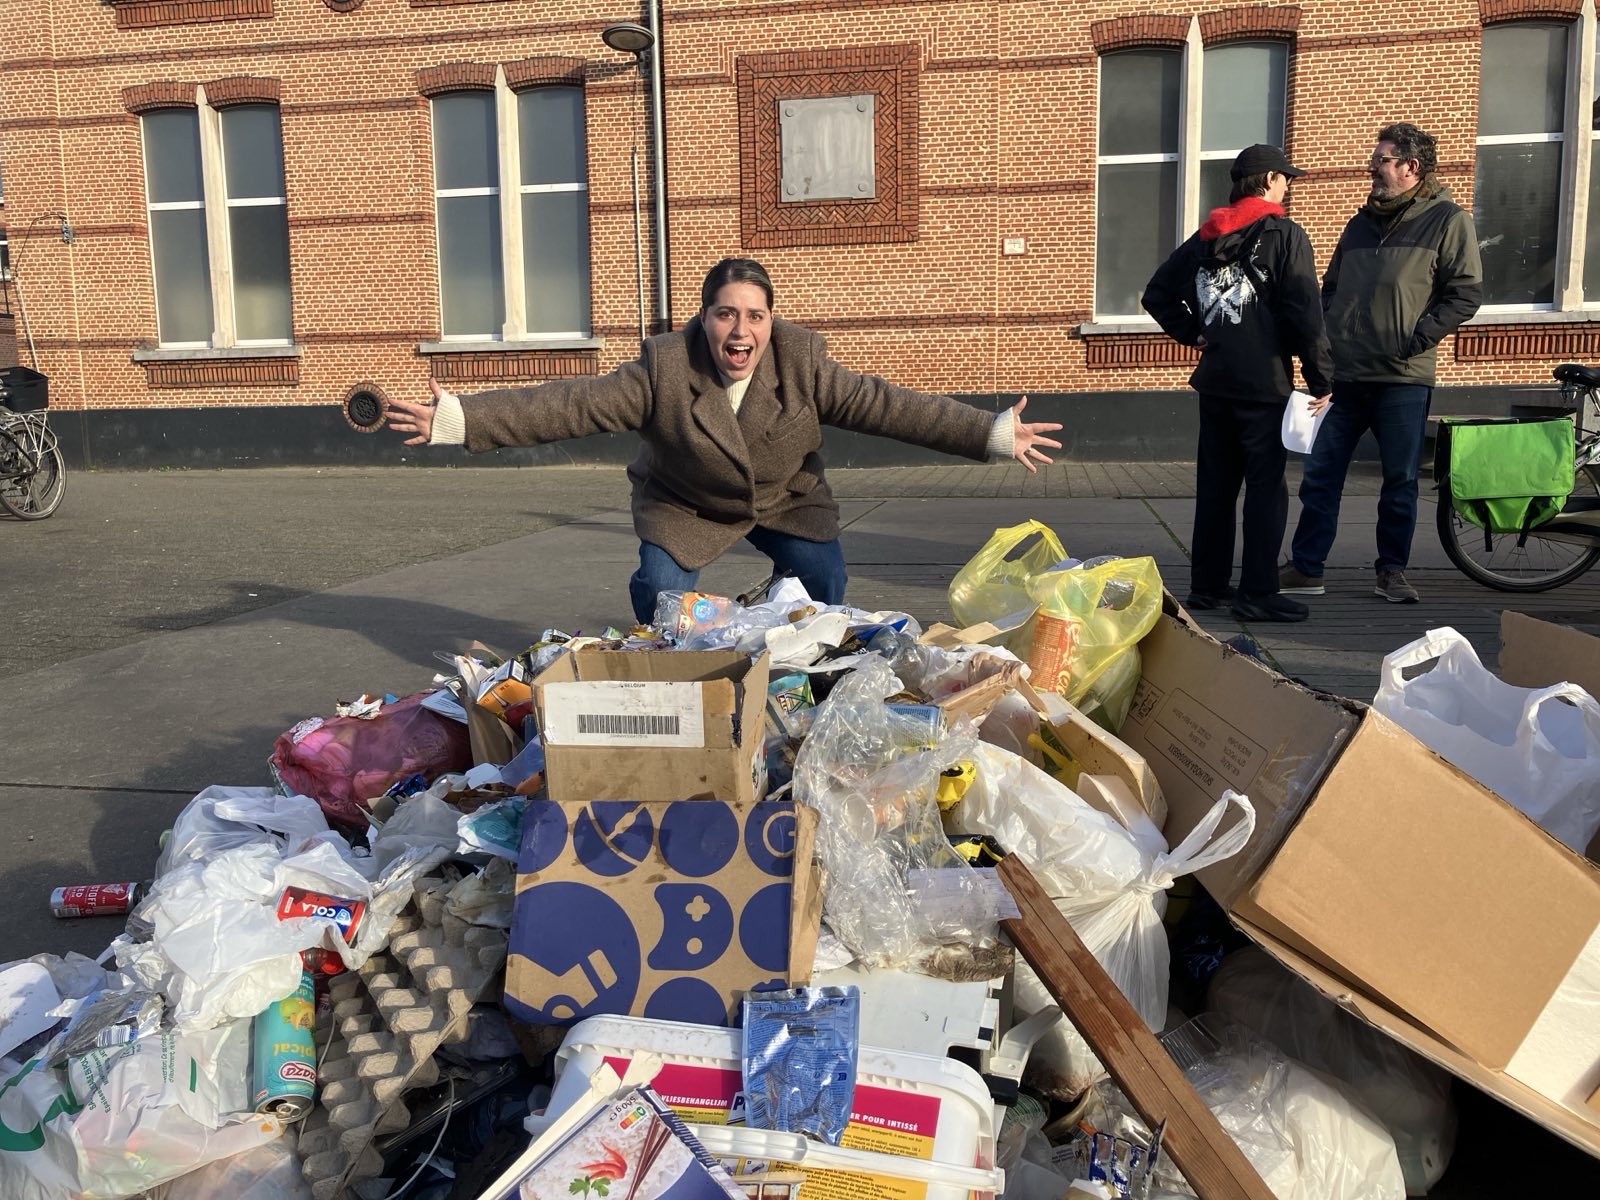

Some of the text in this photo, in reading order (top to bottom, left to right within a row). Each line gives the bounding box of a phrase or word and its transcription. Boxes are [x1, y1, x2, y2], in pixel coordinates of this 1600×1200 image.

[302, 902, 336, 917] COLA
[662, 1095, 727, 1107] VLIESBEHANGLIJM
[733, 1096, 745, 1110] P
[862, 1115, 885, 1125] POUR
[887, 1120, 918, 1132] INTISSÉ
